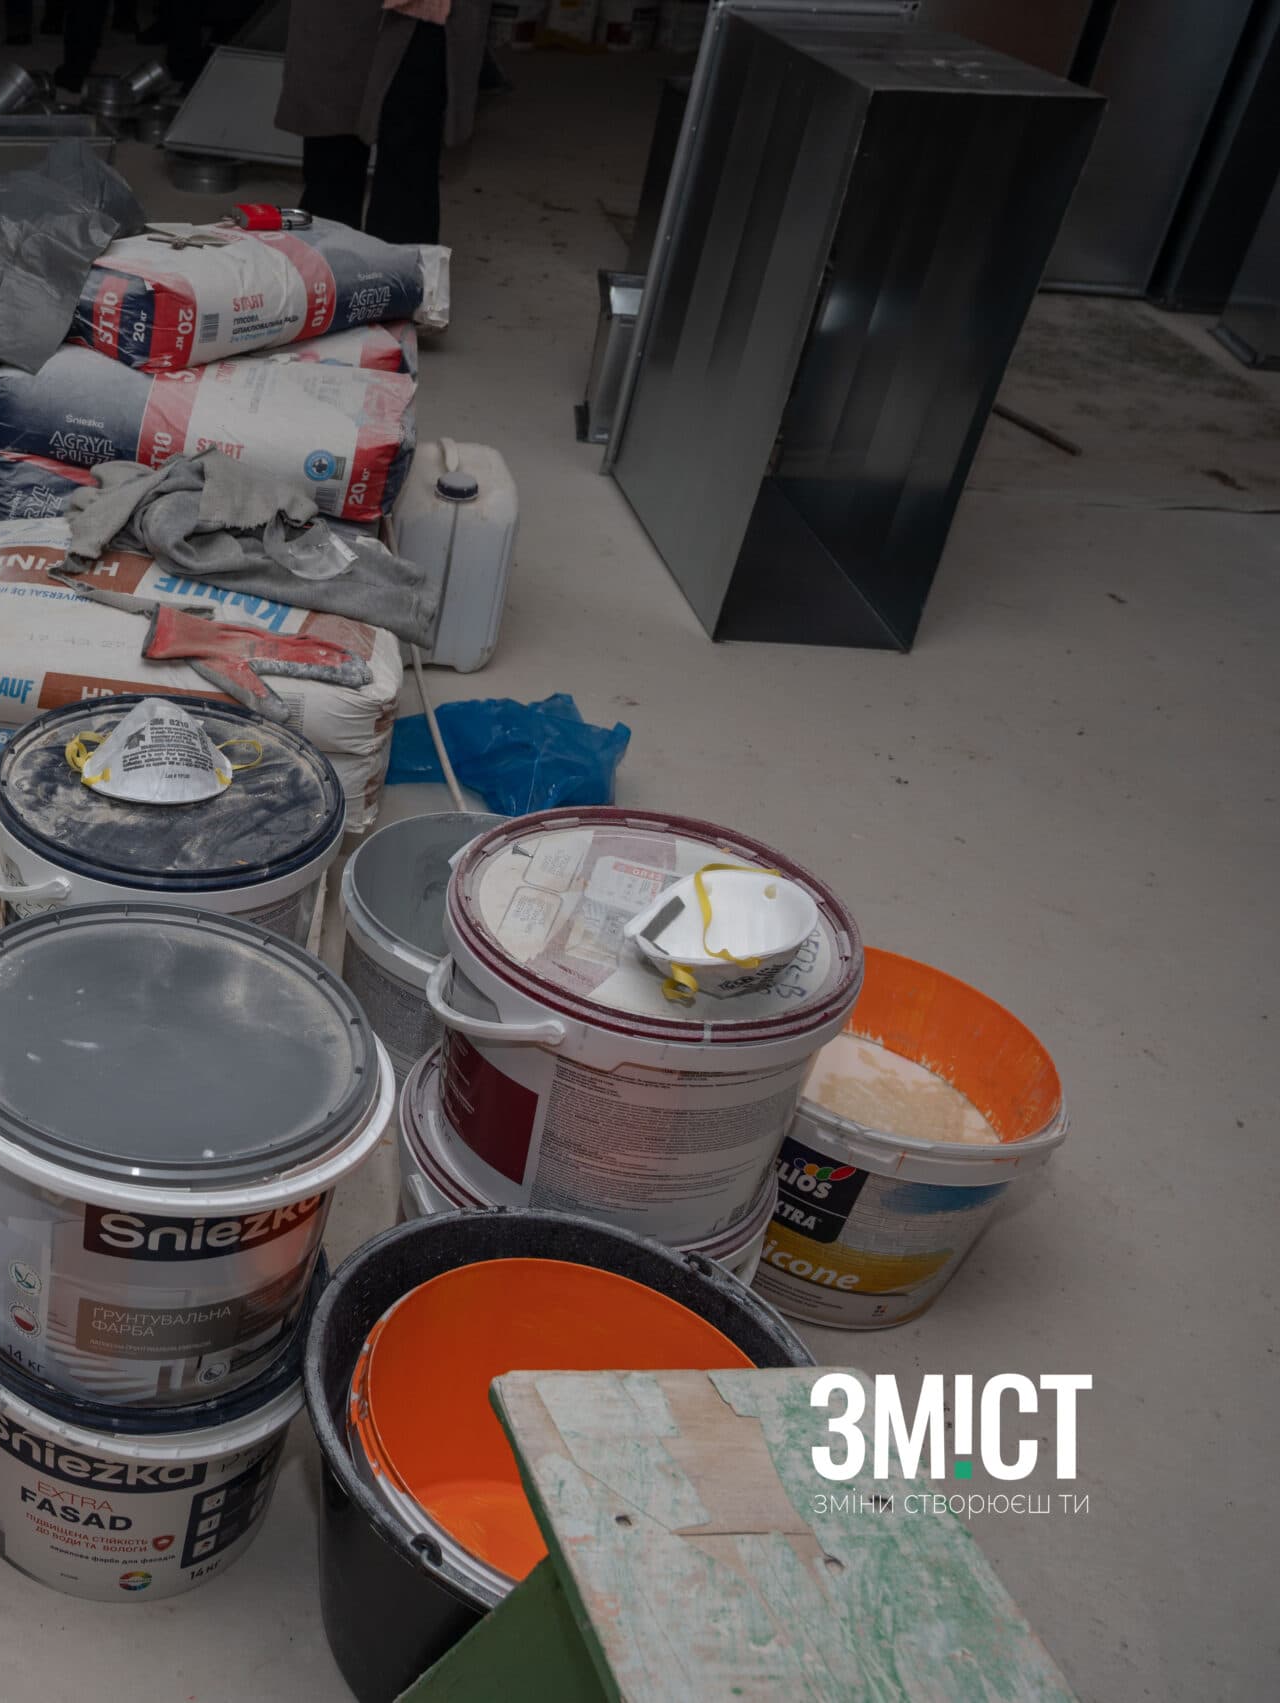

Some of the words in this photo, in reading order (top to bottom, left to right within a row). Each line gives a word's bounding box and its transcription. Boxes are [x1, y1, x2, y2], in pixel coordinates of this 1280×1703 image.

[233, 293, 264, 312] START
[312, 283, 328, 328] ST10
[98, 292, 118, 345] ST10
[133, 323, 146, 342] 20
[178, 308, 193, 334] 20
[196, 438, 245, 460] START
[349, 483, 368, 504] 20
[776, 1161, 832, 1199] LIOS
[91, 1319, 155, 1338] ФАРБА
[20, 1486, 133, 1531] FASAD
[36, 1480, 113, 1512] EXTRA
[25, 1512, 89, 1541] ПІДВИЩЕНА
[35, 1525, 50, 1536] ДО
[52, 1533, 81, 1547] ВОДИ
[85, 1543, 97, 1551] ТА
[102, 1545, 148, 1553] ВОЛОГИ
